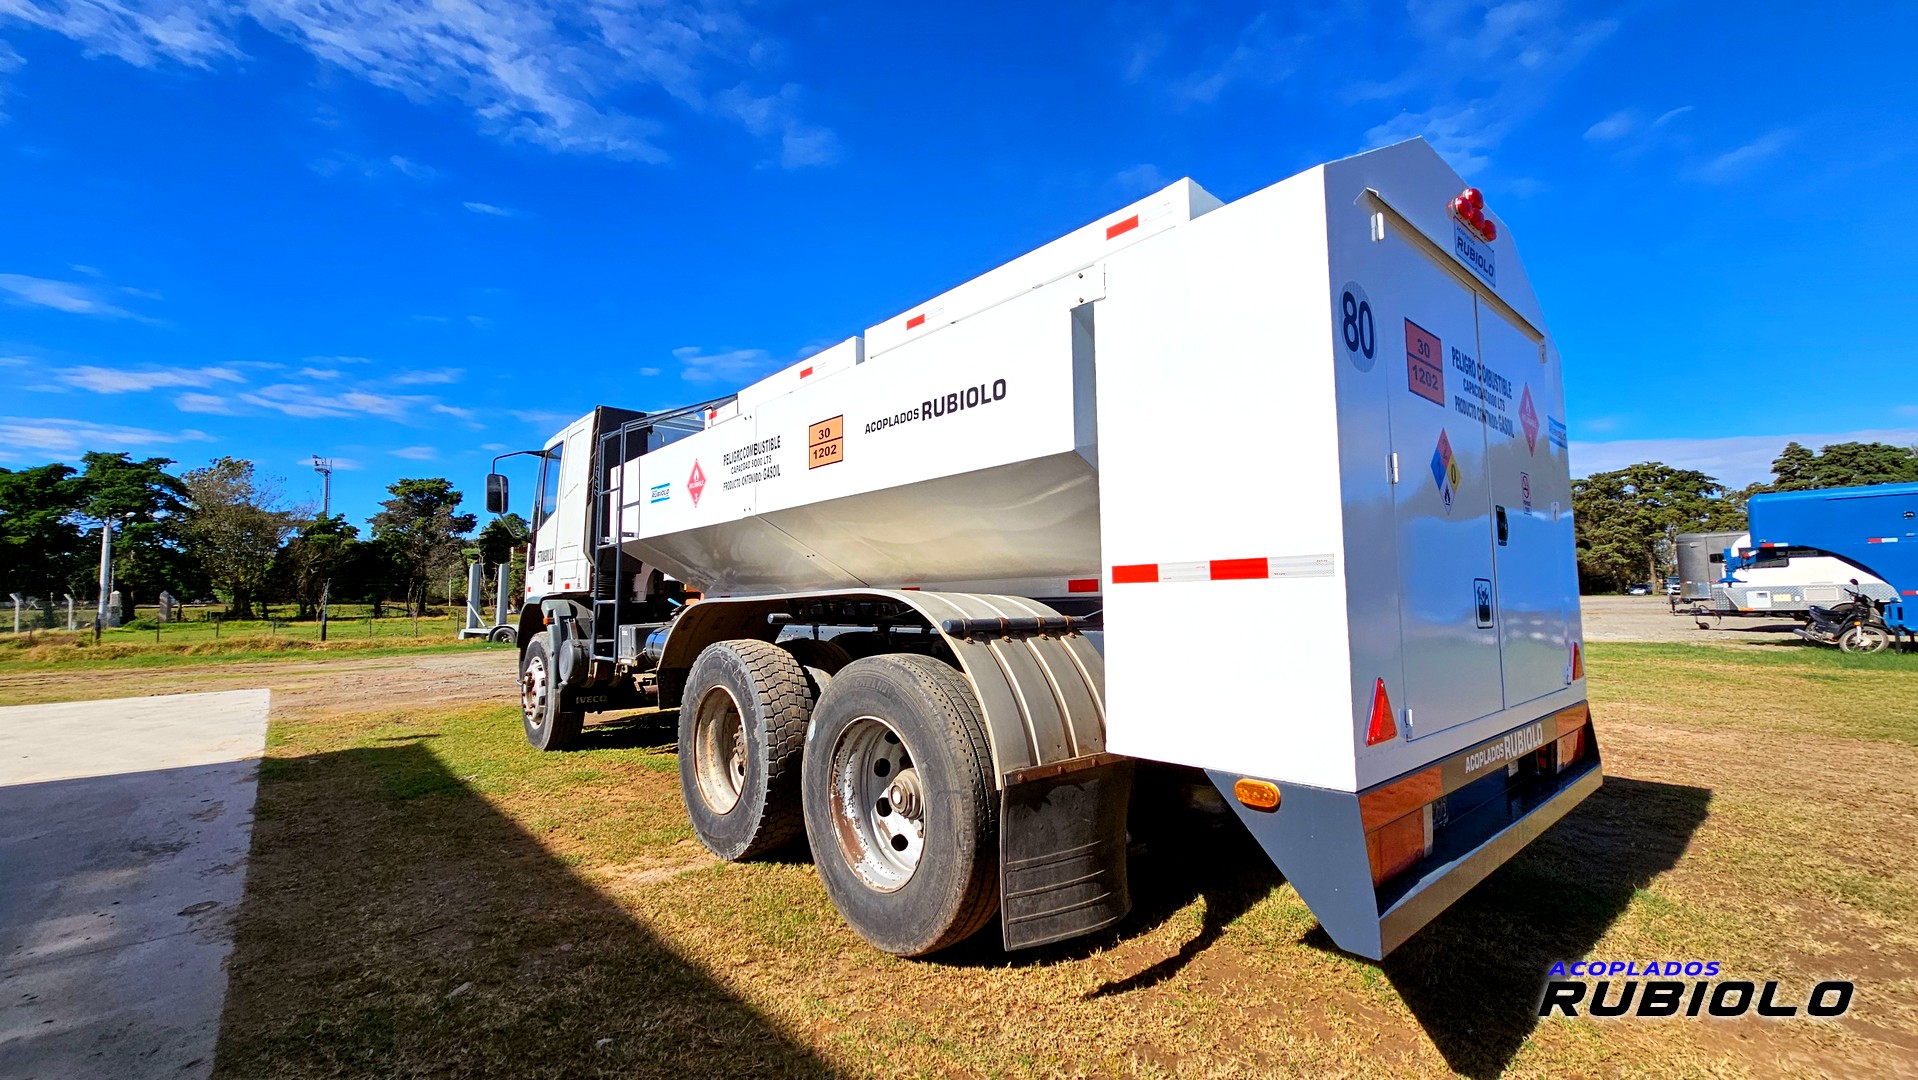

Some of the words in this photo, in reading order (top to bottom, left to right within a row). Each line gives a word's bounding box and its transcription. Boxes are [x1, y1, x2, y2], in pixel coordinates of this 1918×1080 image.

[1457, 236, 1494, 277] RUBIOLO
[1342, 291, 1375, 359] 80
[1417, 339, 1430, 358] 30
[1413, 365, 1439, 391] 1202
[865, 408, 920, 434] ACOPLADOS
[922, 378, 1007, 421] RUBIOLO
[818, 427, 831, 440] 30
[764, 455, 772, 465] LTS
[813, 444, 837, 460] 1202
[1450, 463, 1457, 484] 0
[576, 695, 607, 704] IVECO
[1465, 743, 1504, 773] ACOPLADOS
[1504, 722, 1543, 760] RUBIOLO
